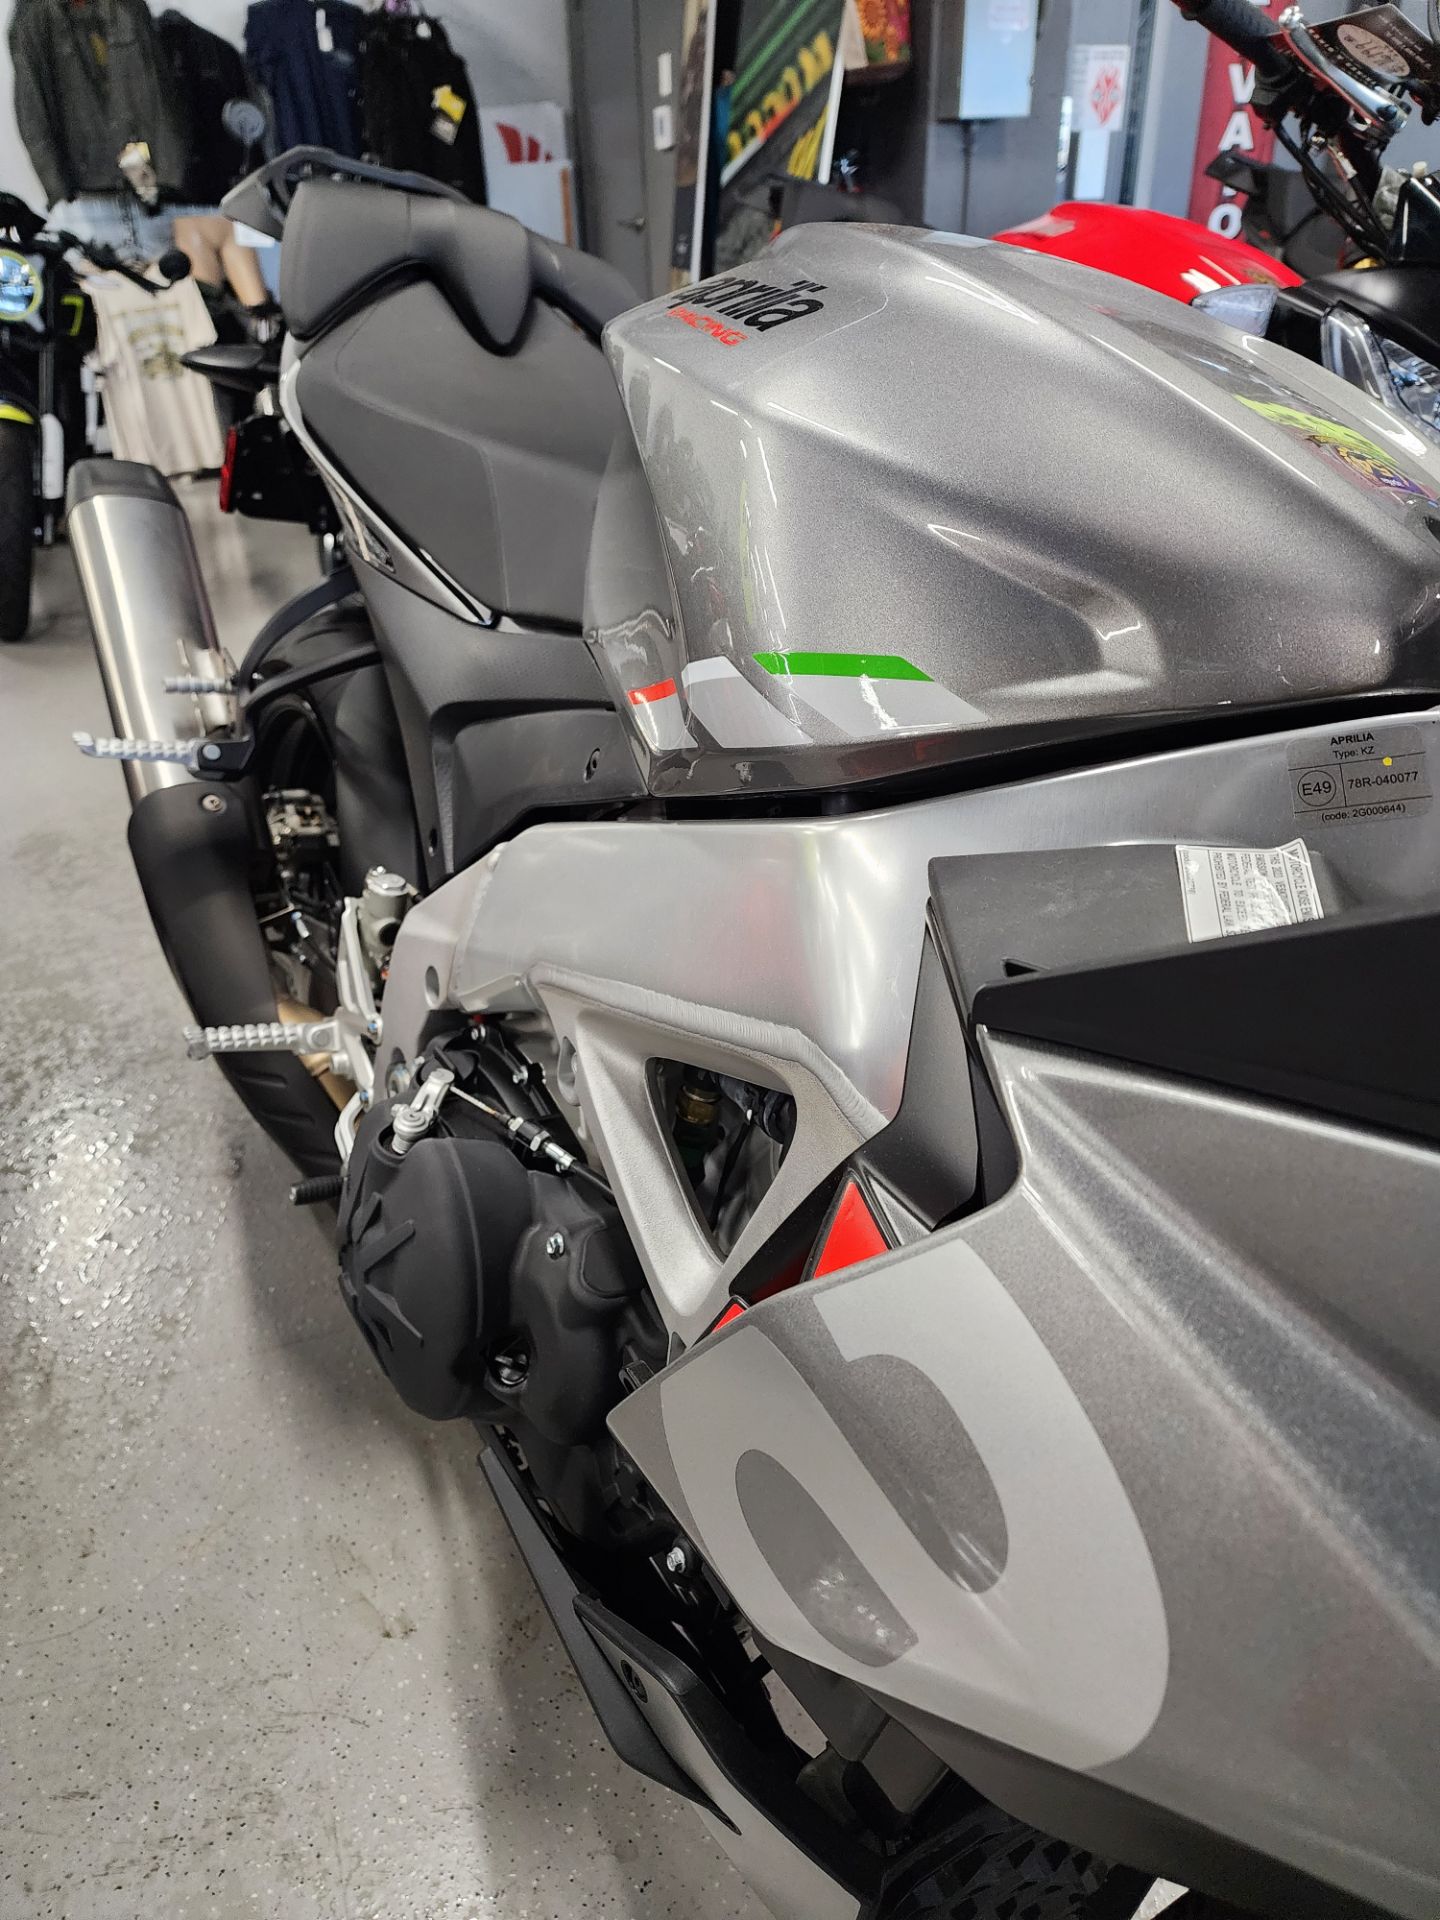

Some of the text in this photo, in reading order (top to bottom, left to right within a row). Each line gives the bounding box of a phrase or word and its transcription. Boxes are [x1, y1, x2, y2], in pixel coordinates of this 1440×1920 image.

[1330, 732, 1375, 746] APRILIA
[1332, 745, 1375, 760] Type: KZ
[1301, 780, 1332, 796] E49
[1347, 771, 1419, 790] 78R-040077
[1321, 803, 1406, 823] (code: 2G000644)
